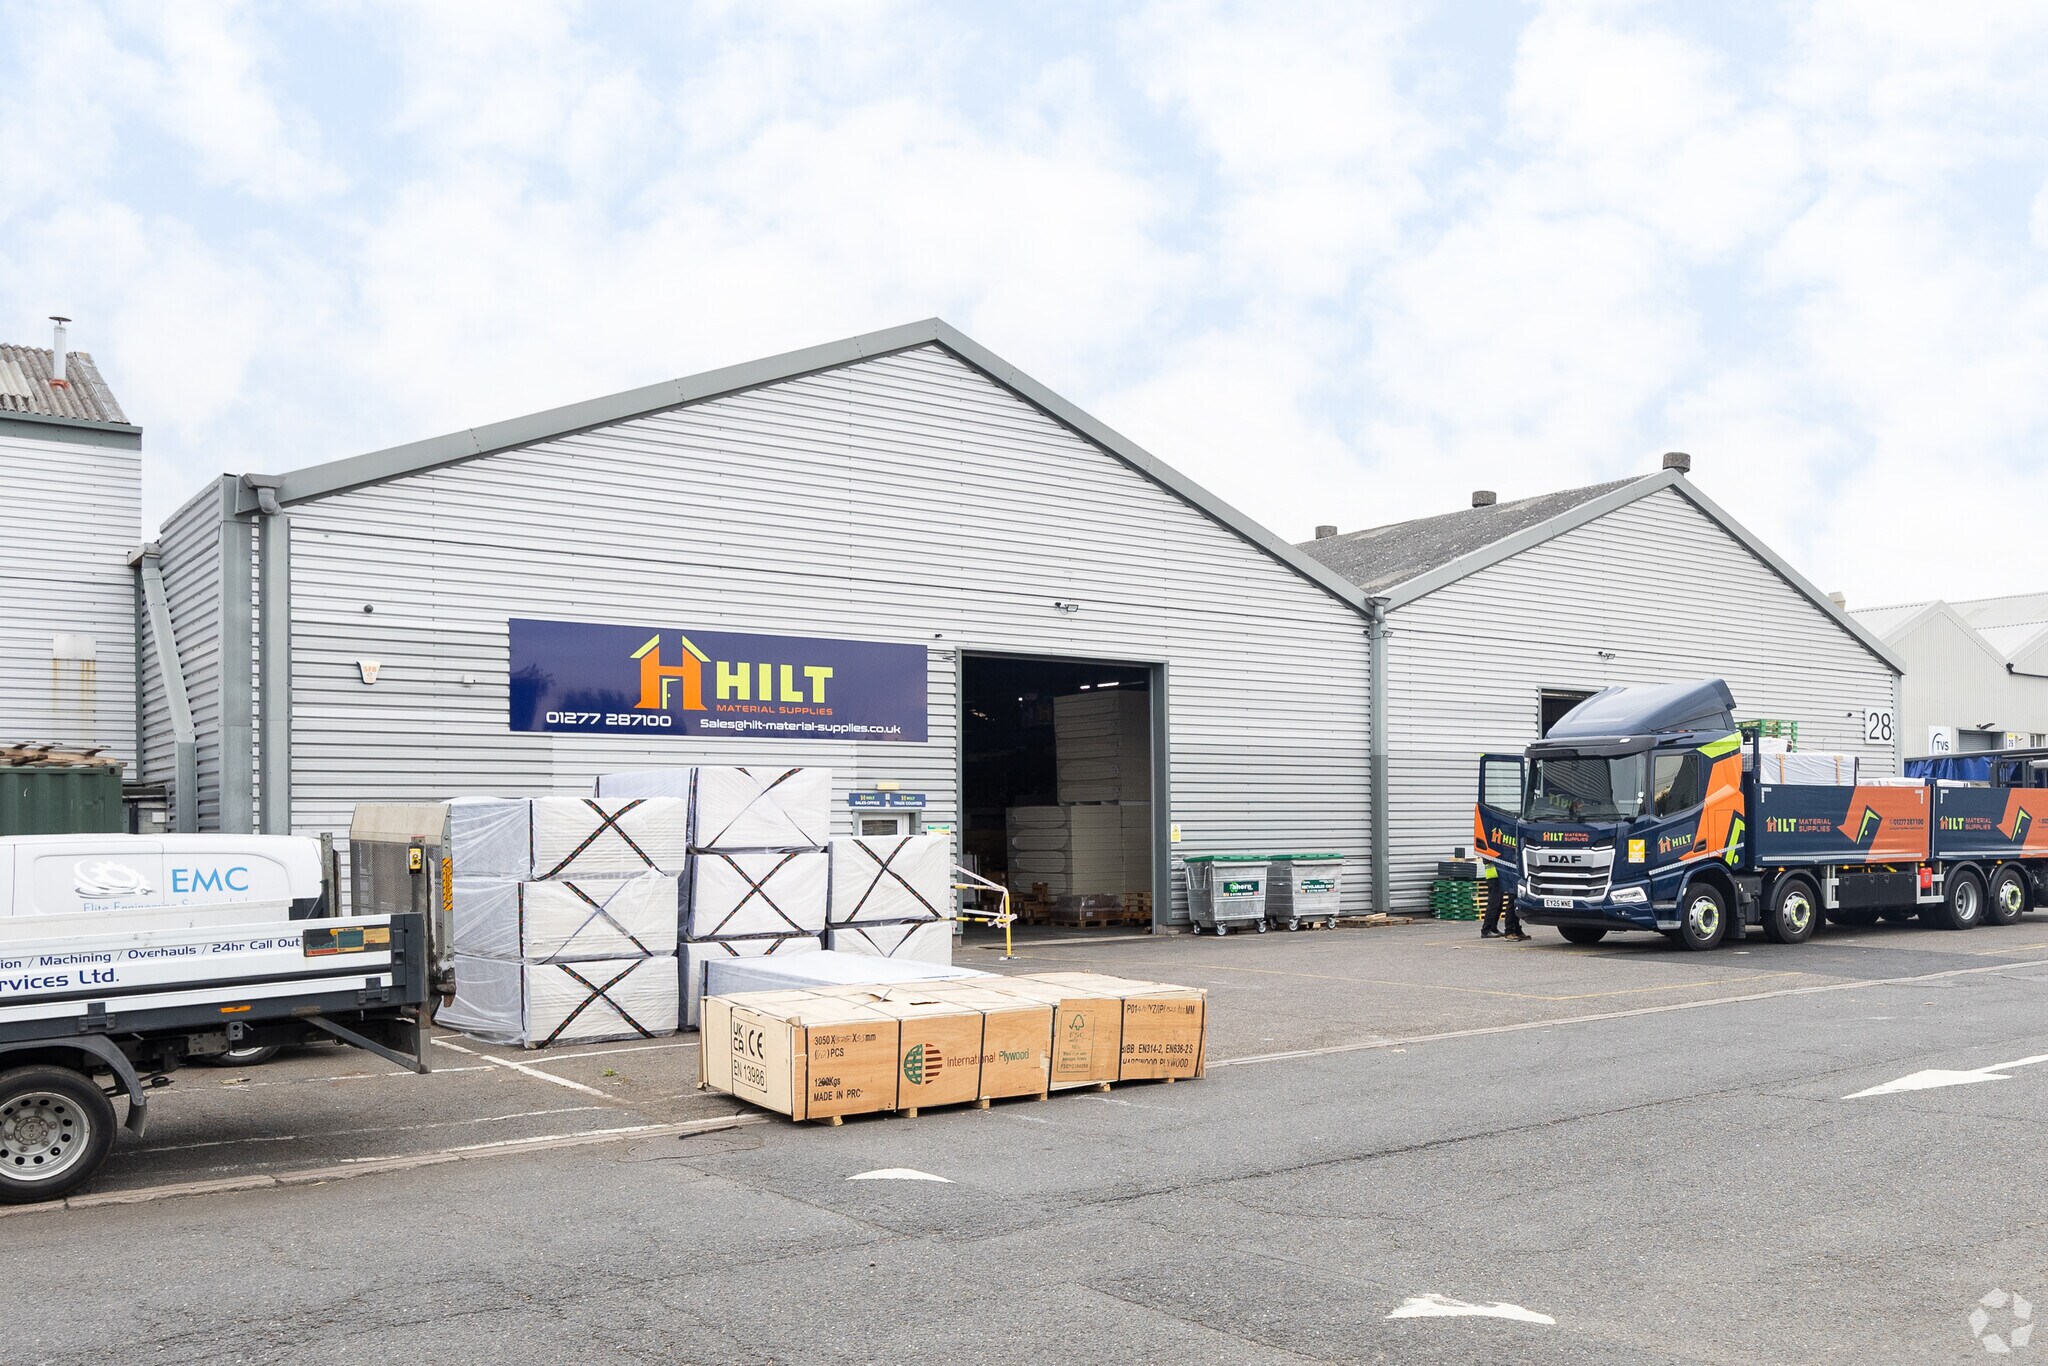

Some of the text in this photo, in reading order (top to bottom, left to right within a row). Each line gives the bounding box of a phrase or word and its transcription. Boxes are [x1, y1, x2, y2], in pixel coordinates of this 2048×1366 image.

[716, 661, 834, 704] HILT
[716, 704, 833, 716] MATERIAL SUPPLIES
[546, 711, 672, 727] 01277 287100
[700, 718, 901, 734] Sales@hilt-material-supplies.co.uk
[1869, 712, 1892, 741] 28
[1936, 741, 1949, 751] TVS
[1766, 816, 1797, 832] HILT
[1940, 816, 1964, 830] HILT
[1502, 834, 1517, 847] HIL
[1543, 832, 1563, 841] HILT
[1672, 834, 1691, 847] HILT
[1548, 855, 1581, 863] DAF
[171, 866, 249, 893] EMC
[40, 952, 112, 967] Machining
[128, 945, 197, 959] Overhauls
[212, 942, 245, 953] 24hr
[249, 940, 273, 951] Call
[277, 937, 301, 948] Out
[79, 968, 119, 985] Ltd.
[733, 1021, 743, 1038] UK
[733, 1037, 744, 1054] CA
[998, 1049, 1030, 1065] Plywood
[733, 1059, 765, 1086] EN 13986
[813, 1091, 833, 1102] MADE
[836, 1090, 843, 1099] IN
